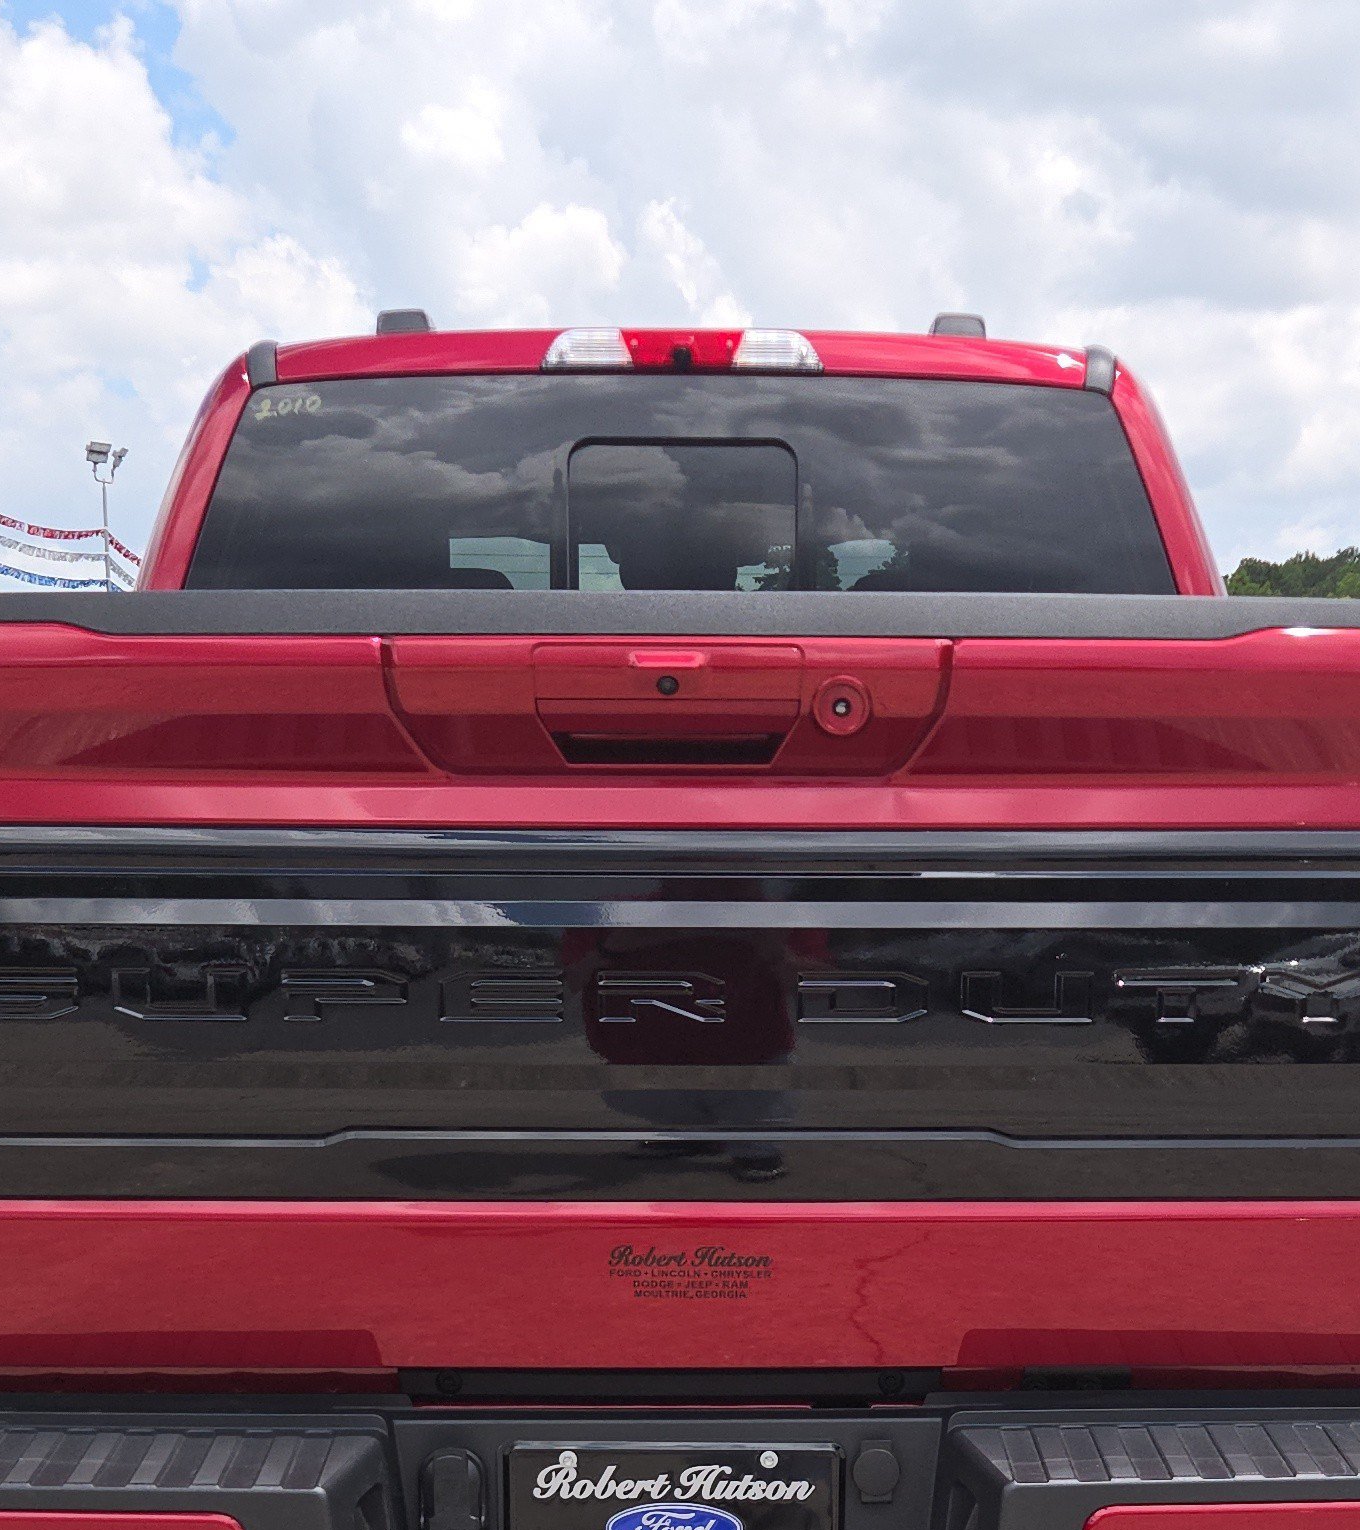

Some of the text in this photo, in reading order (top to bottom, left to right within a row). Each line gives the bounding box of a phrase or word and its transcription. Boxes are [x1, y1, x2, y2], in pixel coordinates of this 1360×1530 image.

[608, 1244, 773, 1268] Robert Hutson
[609, 1270, 773, 1279] FORD LINCOLN CHRYSLER
[685, 1280, 713, 1288] JEEP
[722, 1280, 749, 1288] RAM
[695, 1290, 748, 1299] GEORGIA
[532, 1465, 815, 1501] Robert Hutson
